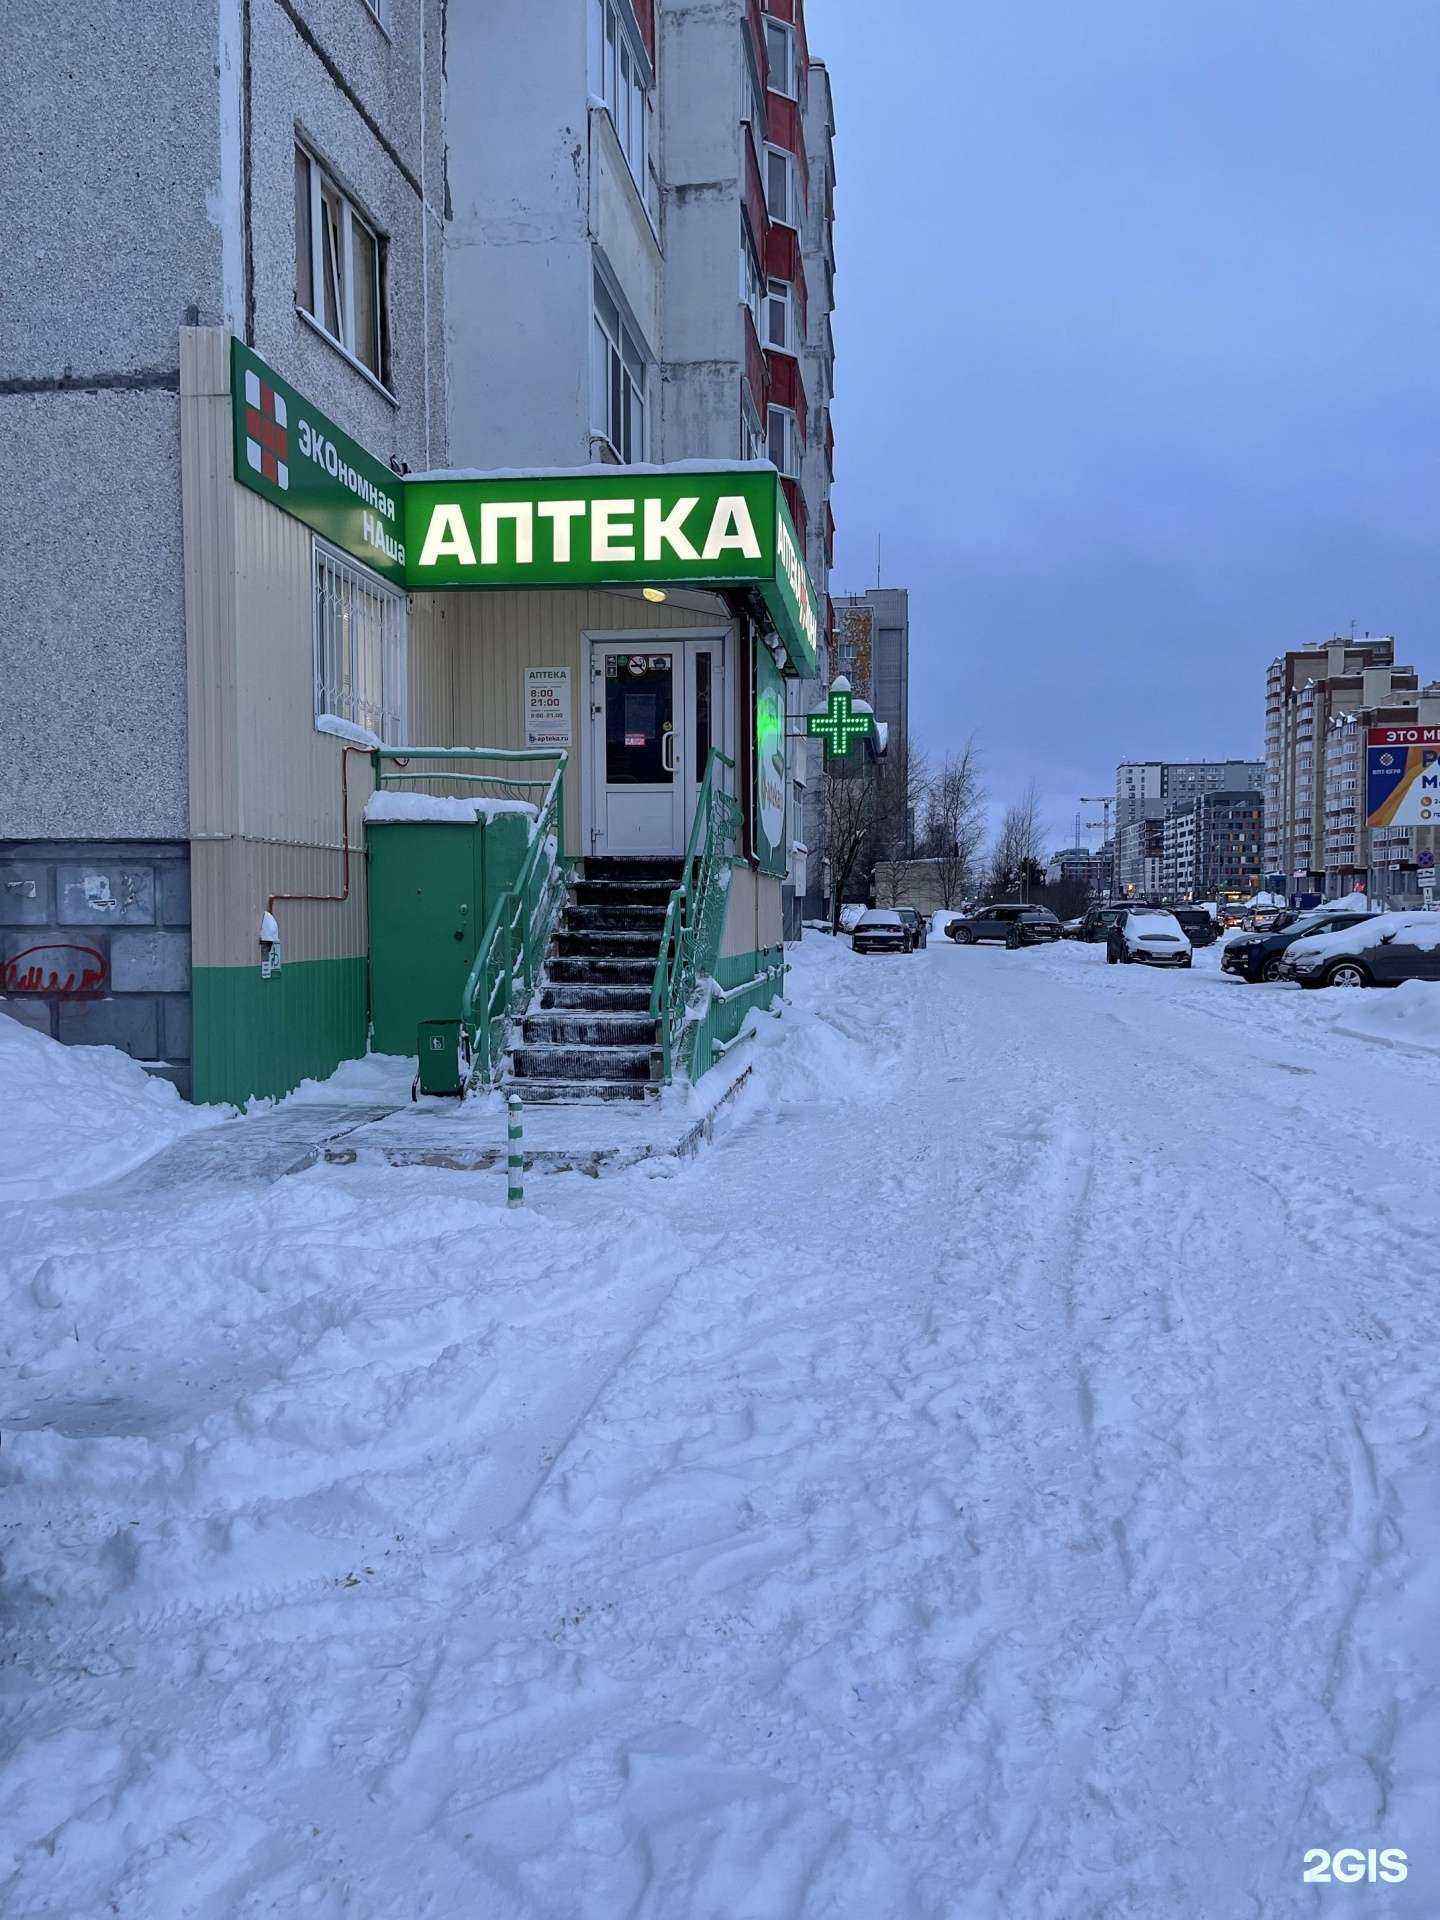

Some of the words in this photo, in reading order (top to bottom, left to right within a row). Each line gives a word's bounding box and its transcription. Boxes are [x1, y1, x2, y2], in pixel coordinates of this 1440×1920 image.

[418, 495, 762, 566] АПТЕКА
[528, 671, 567, 679] АПТЕКА
[530, 689, 554, 698] 8:00
[530, 698, 561, 707] 21:00
[1386, 730, 1418, 742] ЭТО
